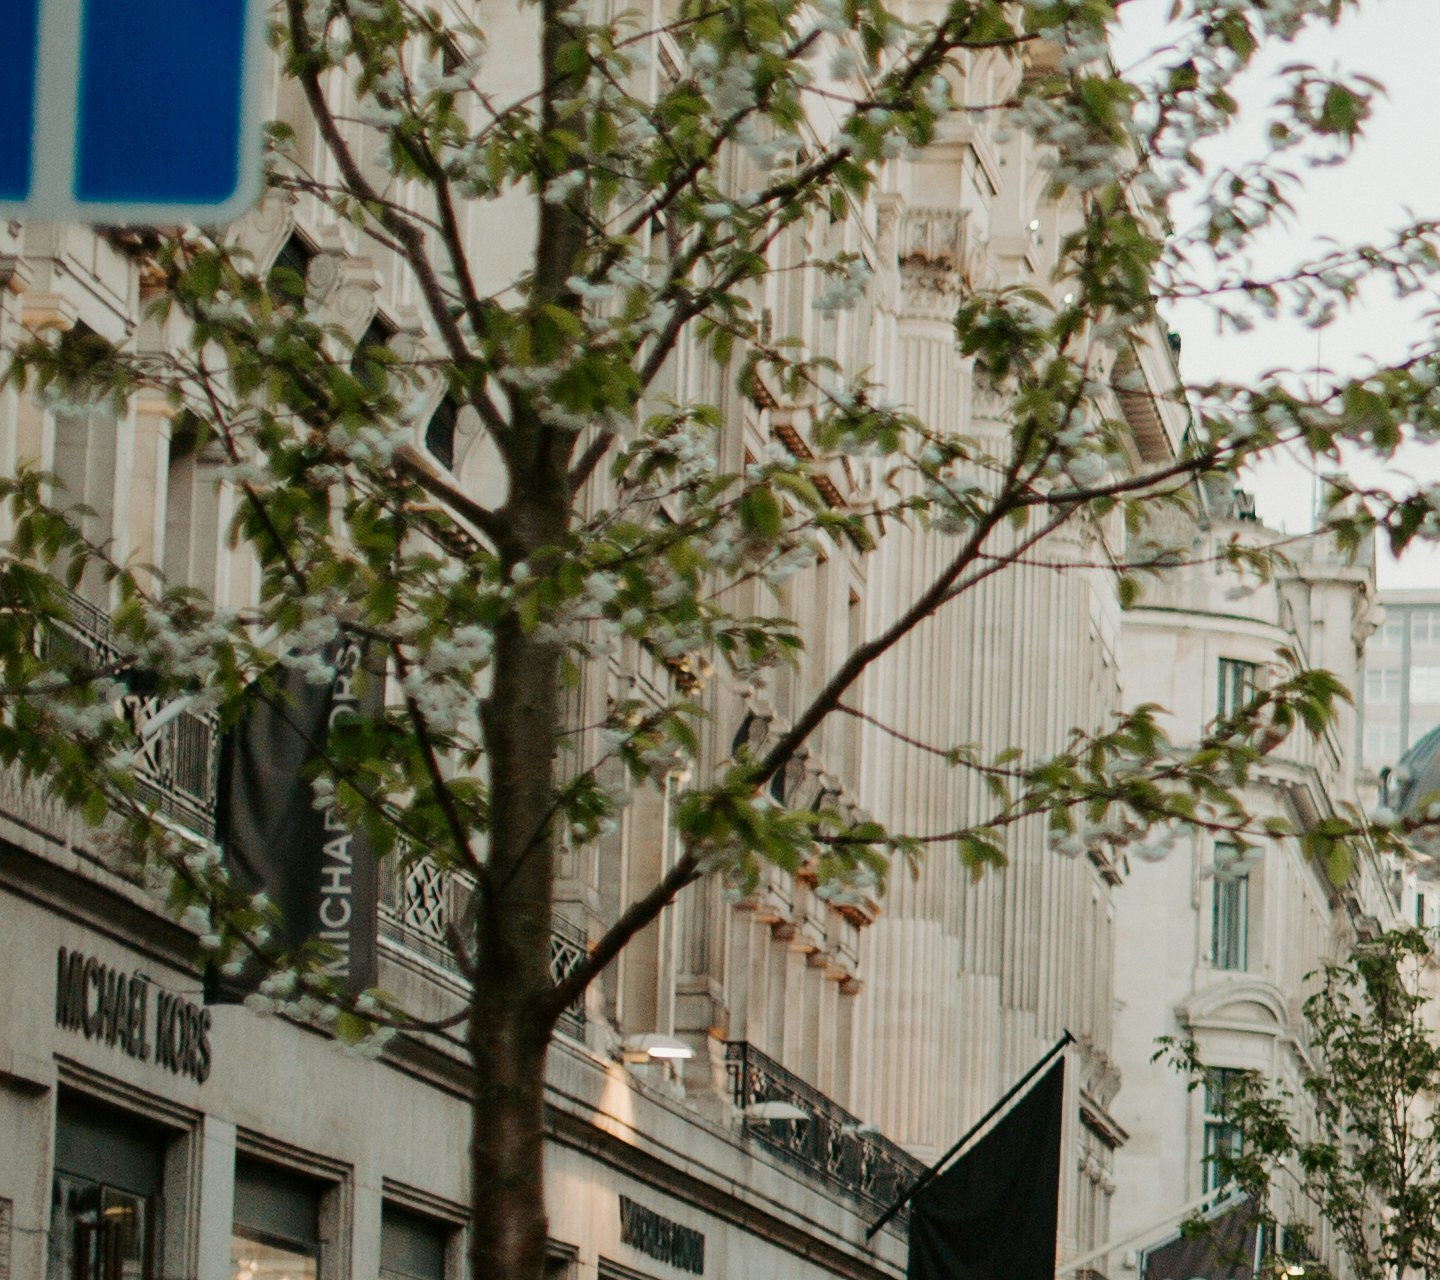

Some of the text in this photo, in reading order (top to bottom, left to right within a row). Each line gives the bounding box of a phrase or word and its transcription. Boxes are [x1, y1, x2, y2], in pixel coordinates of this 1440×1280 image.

[318, 792, 352, 978] MICHA
[55, 945, 212, 1084] MICHAEL KORS
